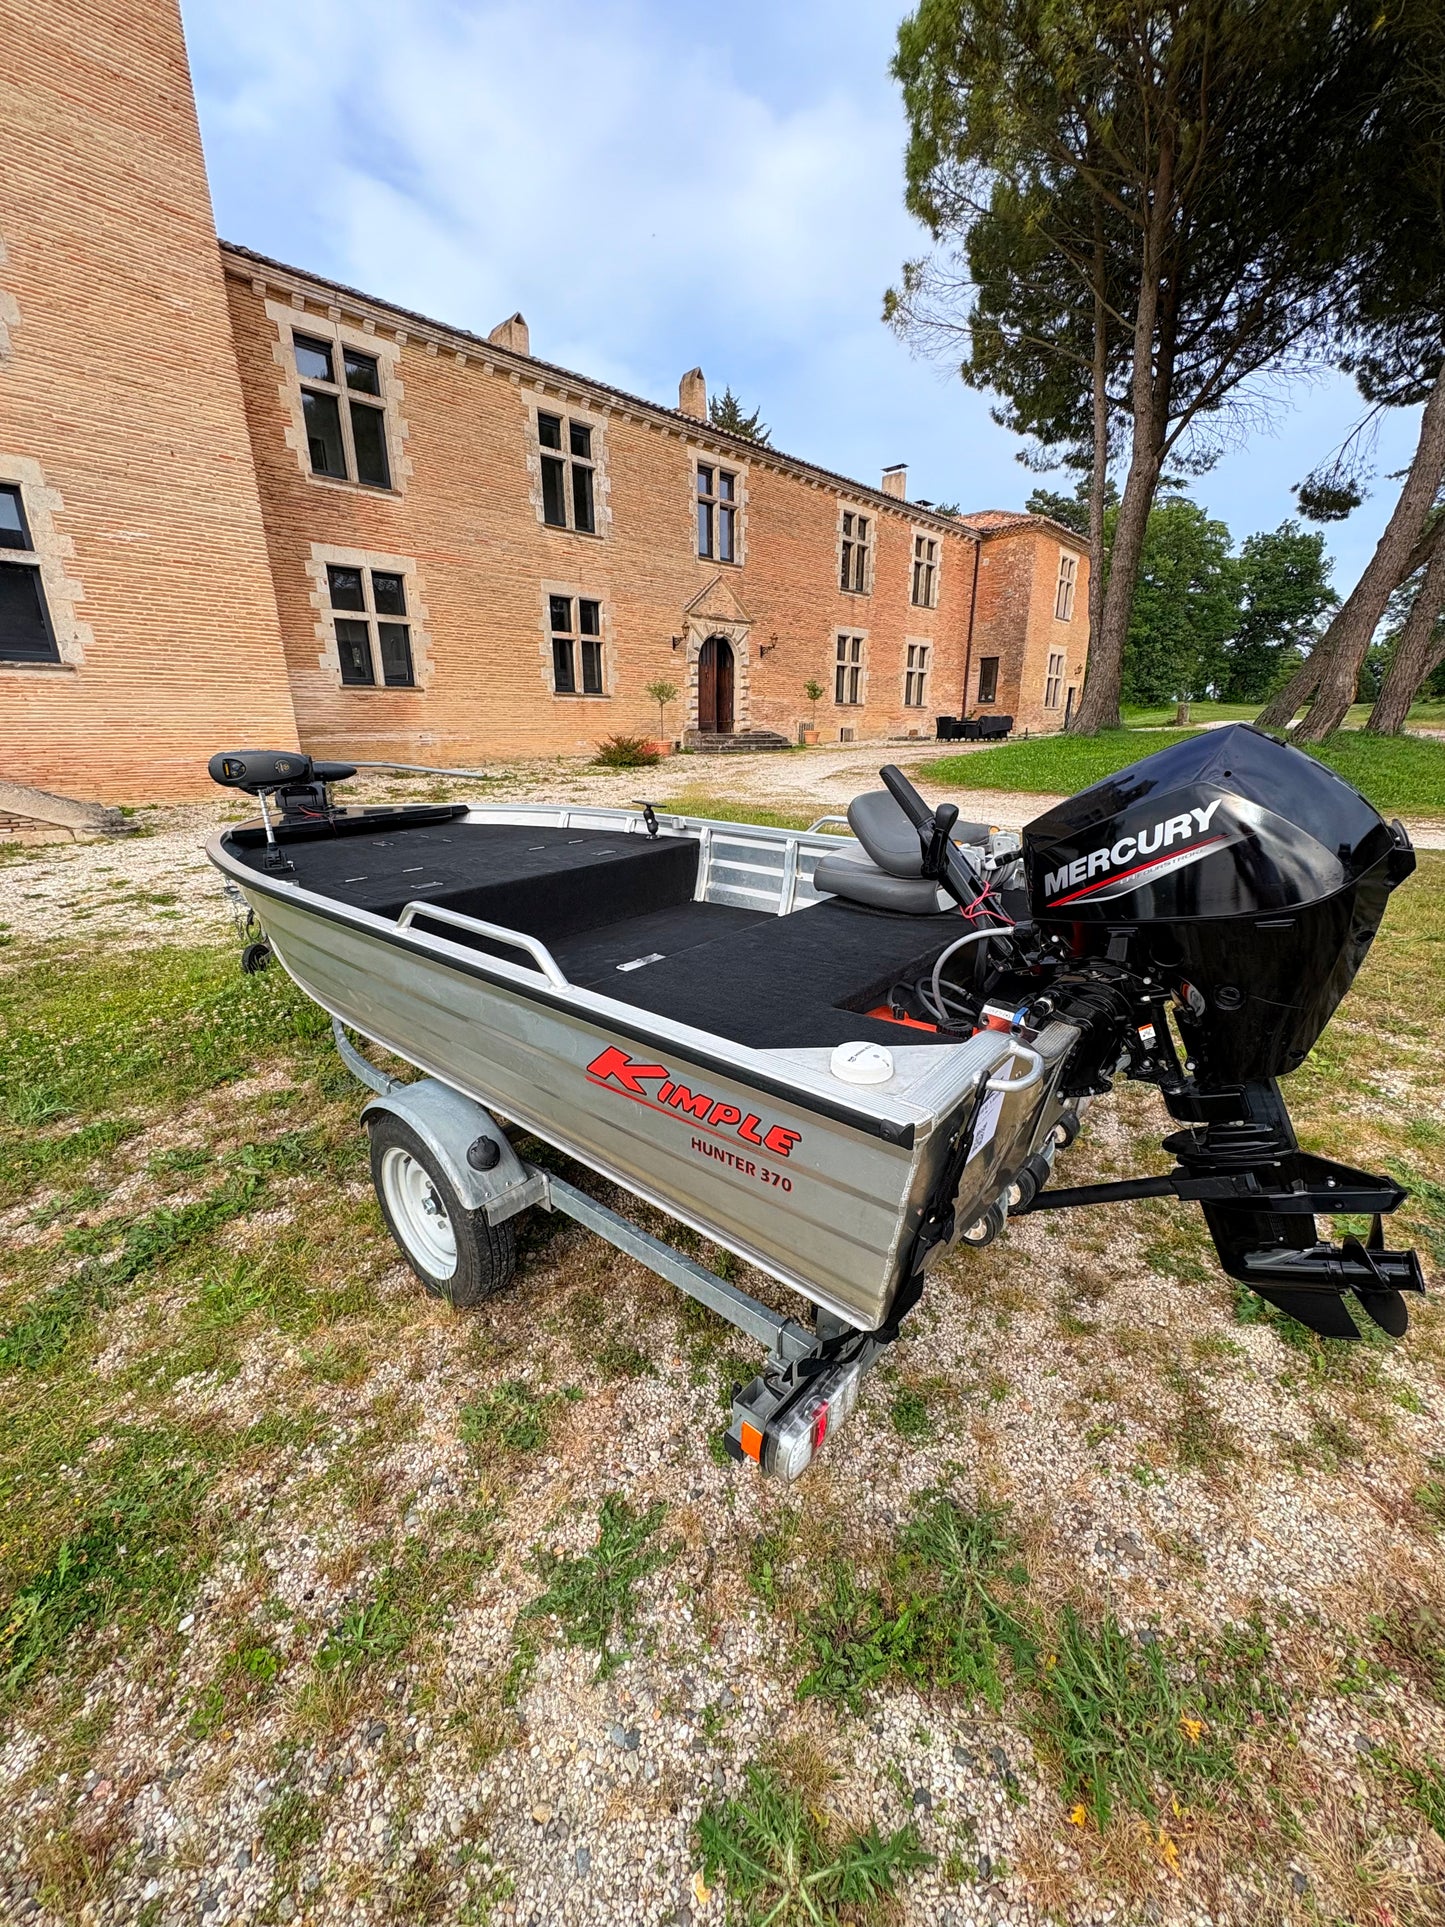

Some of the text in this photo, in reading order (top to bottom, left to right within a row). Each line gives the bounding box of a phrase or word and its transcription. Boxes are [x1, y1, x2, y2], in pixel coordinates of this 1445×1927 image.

[1044, 799, 1222, 897] MERCURY
[691, 1136, 793, 1192] HUNTER 370
